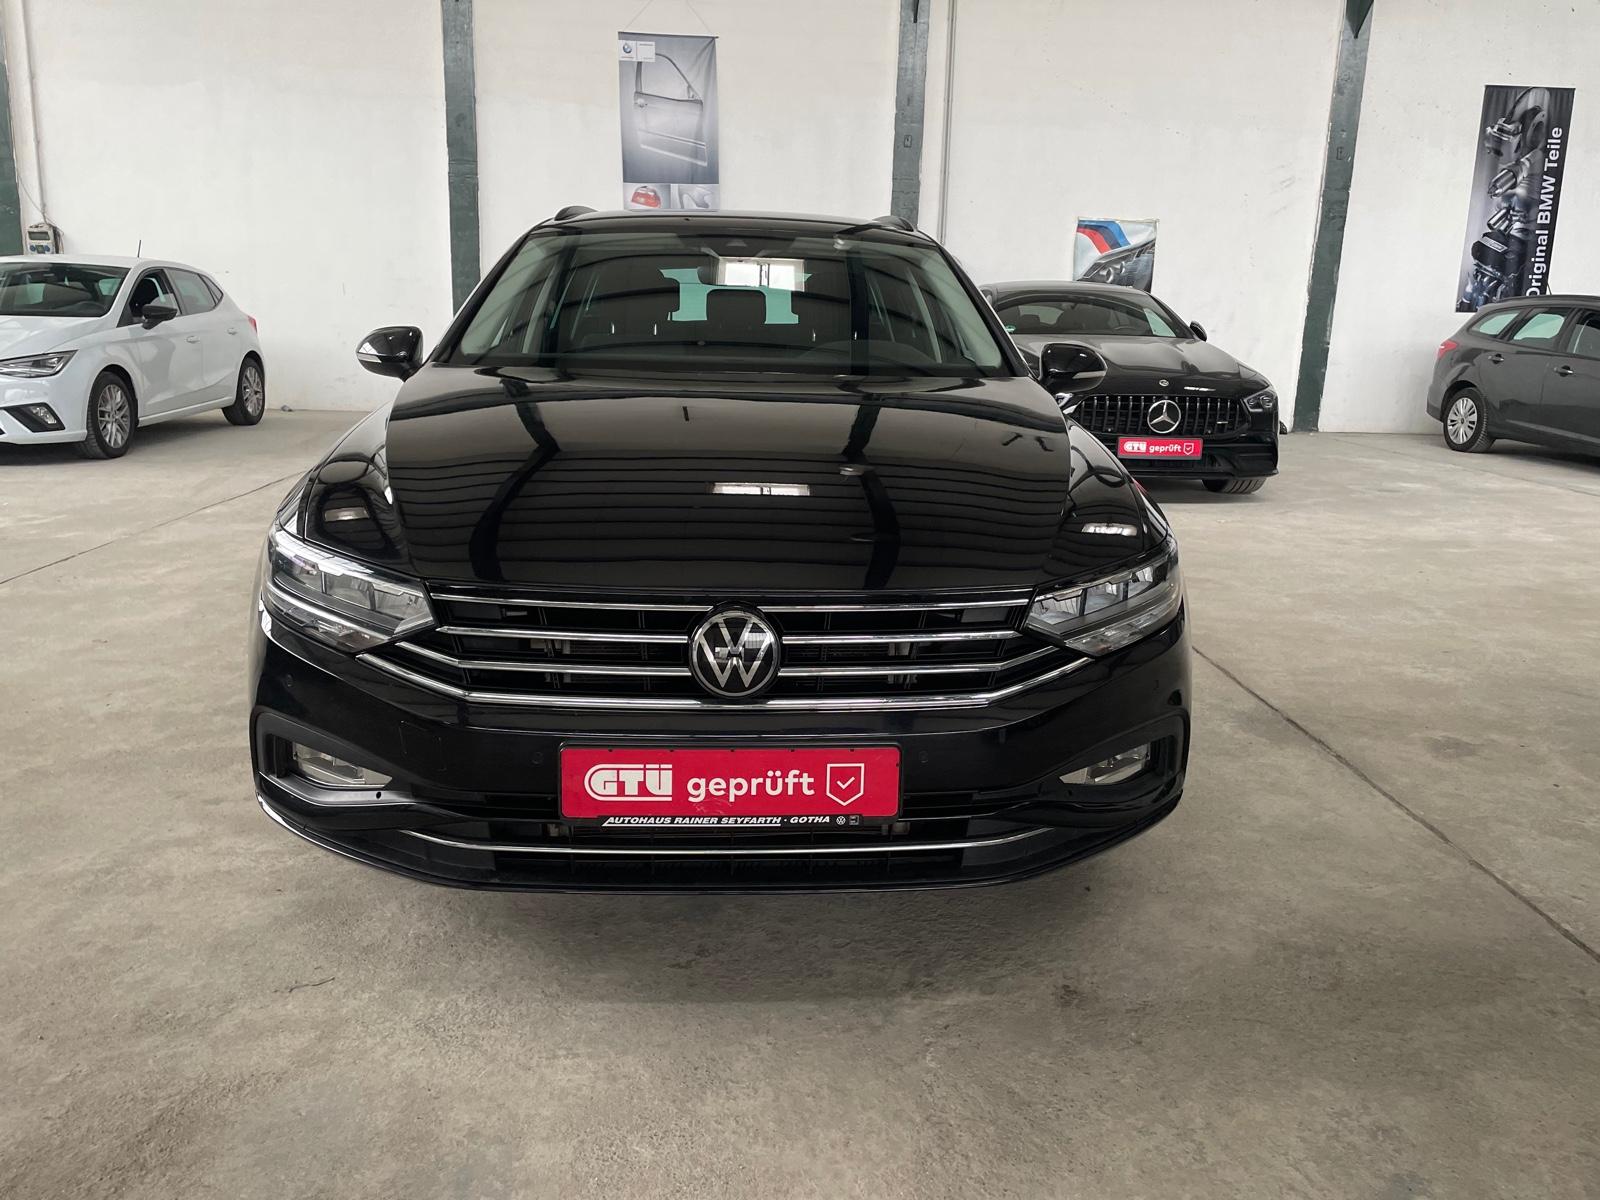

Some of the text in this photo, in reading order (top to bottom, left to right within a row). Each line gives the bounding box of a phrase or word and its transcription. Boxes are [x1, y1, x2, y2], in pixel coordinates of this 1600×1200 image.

[1544, 127, 1563, 172] Teile
[1537, 175, 1556, 224] BMW
[1149, 444, 1182, 453] geprüft
[584, 763, 815, 803] GTÜ geprüft
[605, 816, 671, 825] AUTOHAUS
[674, 816, 718, 825] RAINER
[720, 816, 781, 825] SEYFARTH
[790, 815, 830, 824] GOTHA
